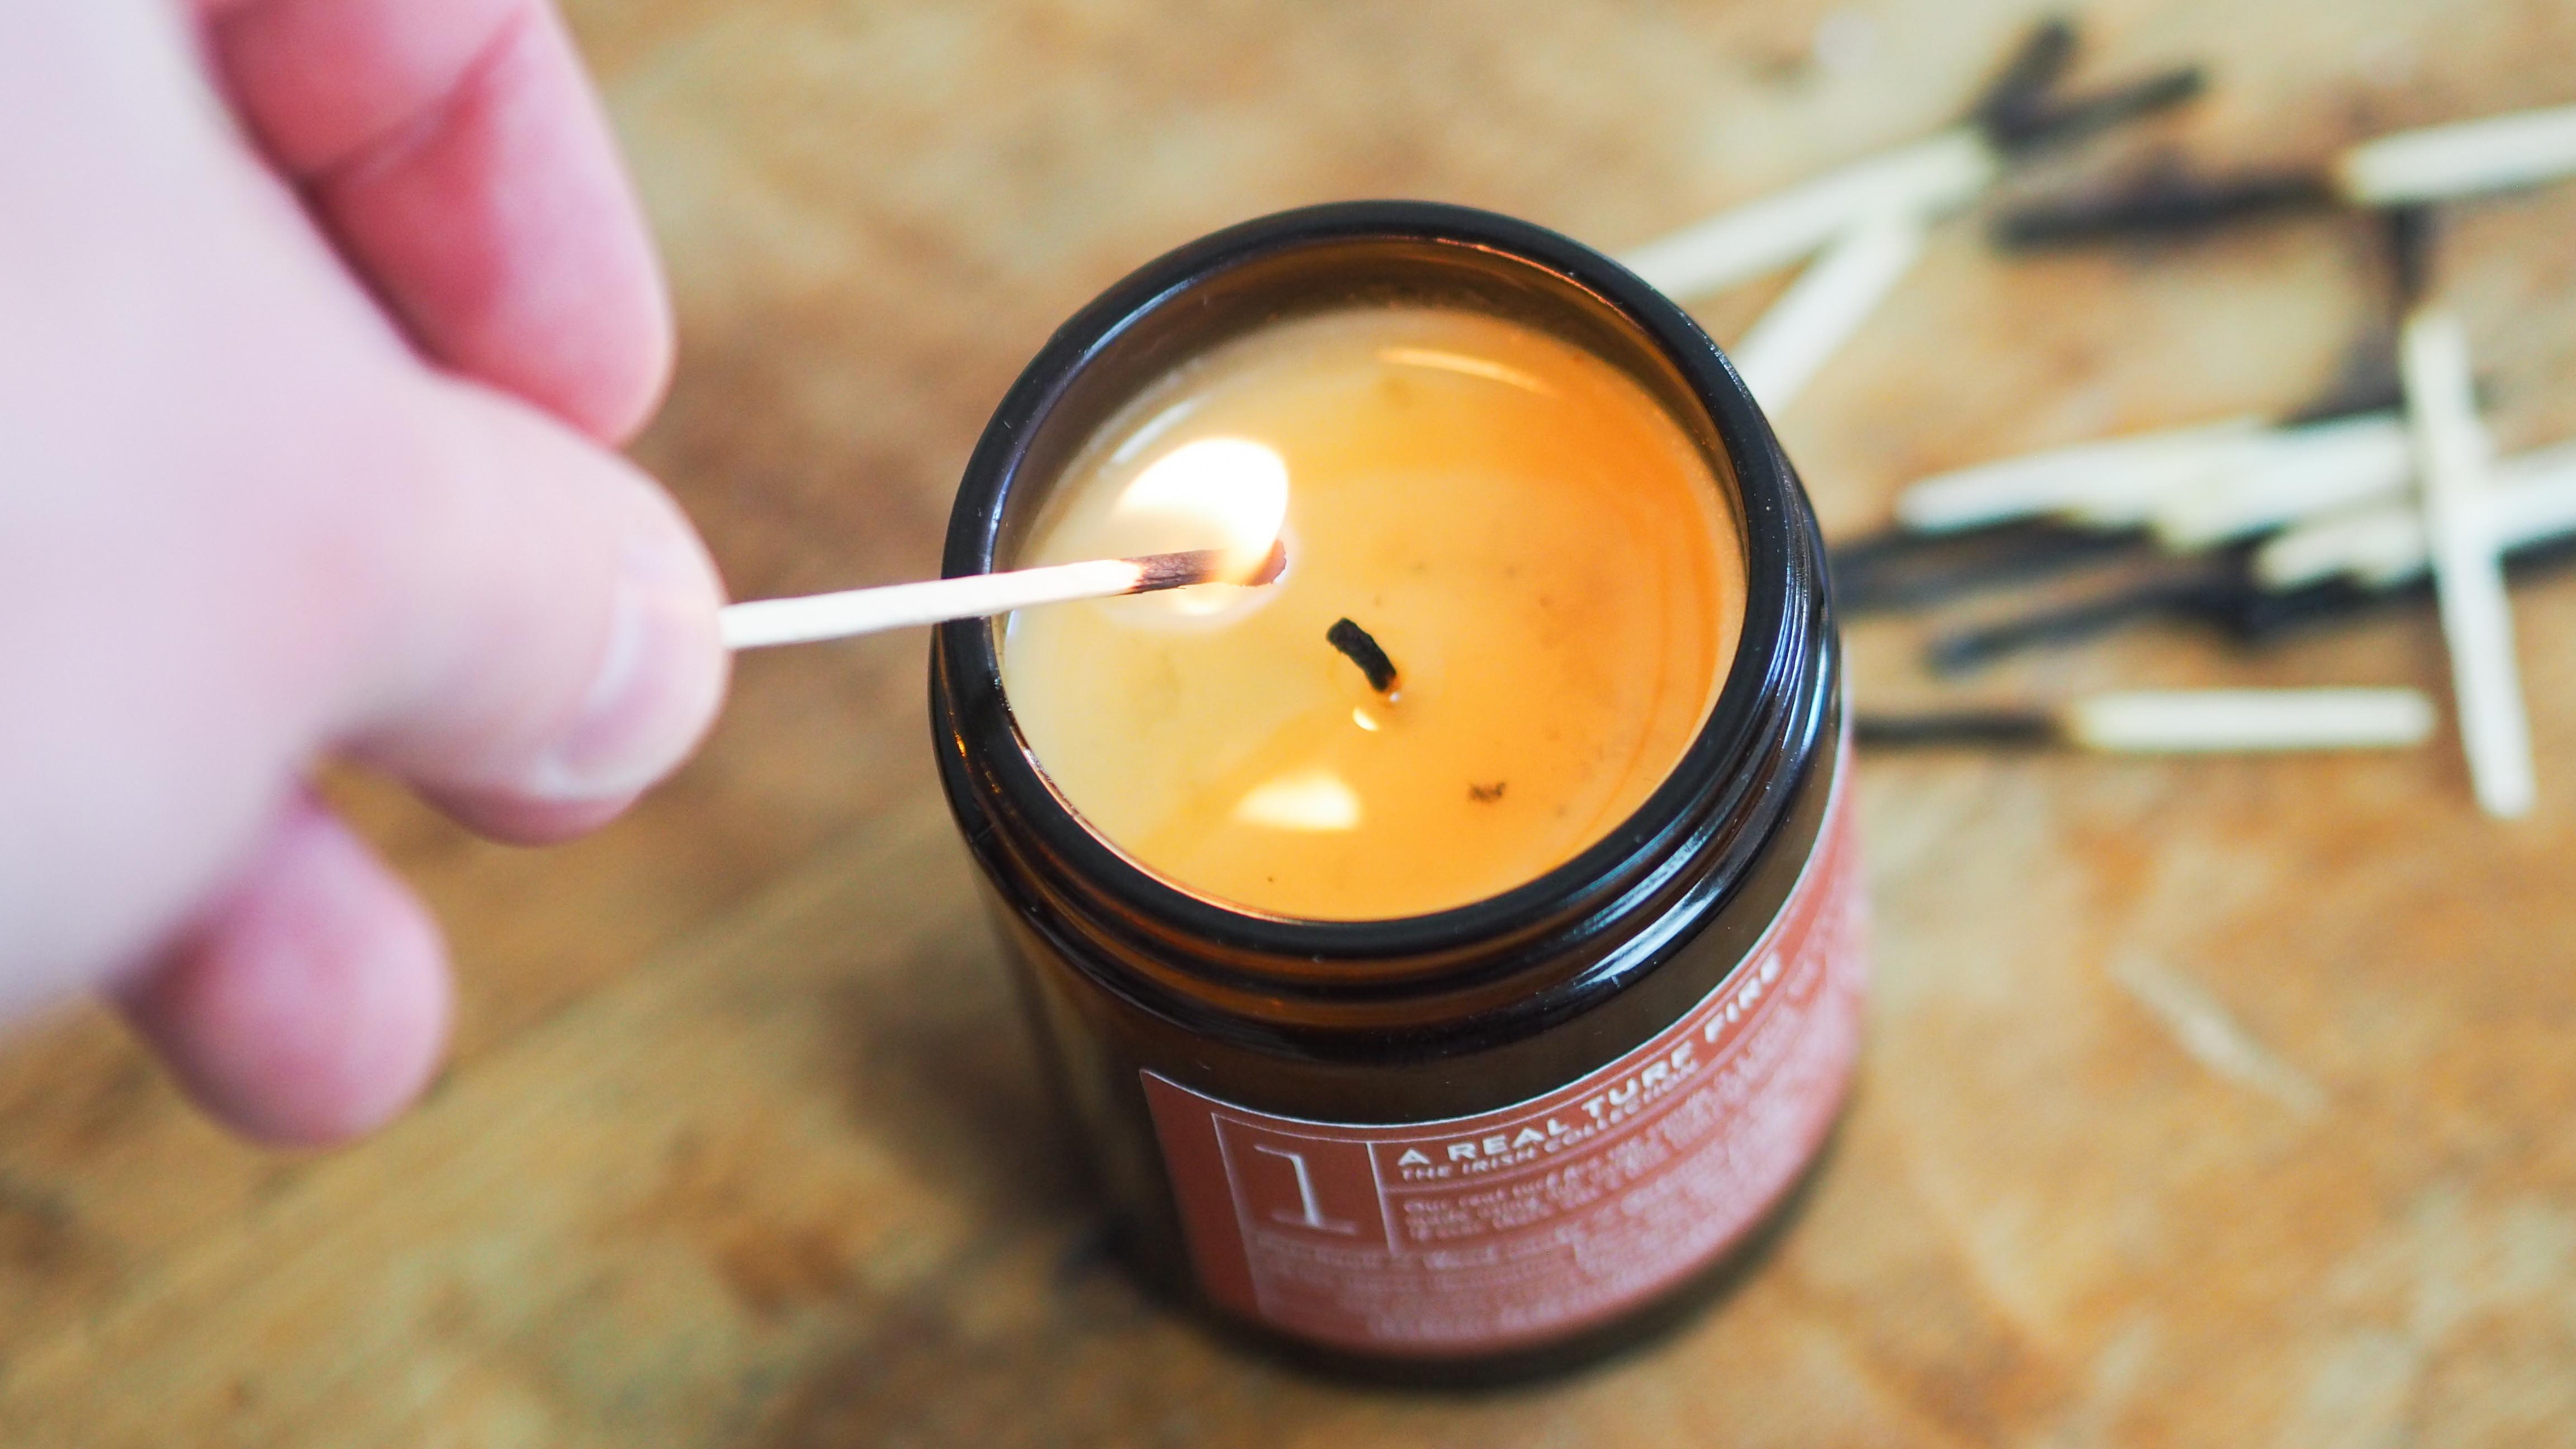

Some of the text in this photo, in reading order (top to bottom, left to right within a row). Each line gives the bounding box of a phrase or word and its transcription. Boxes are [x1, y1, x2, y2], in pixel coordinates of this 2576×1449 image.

[1398, 1147, 1430, 1166] A
[1447, 1118, 1570, 1162] REAL
[1704, 952, 1782, 1044] FIRE
[1401, 1058, 1699, 1181] THE IRISH COLLECTION
[1253, 1144, 1357, 1235] 1
